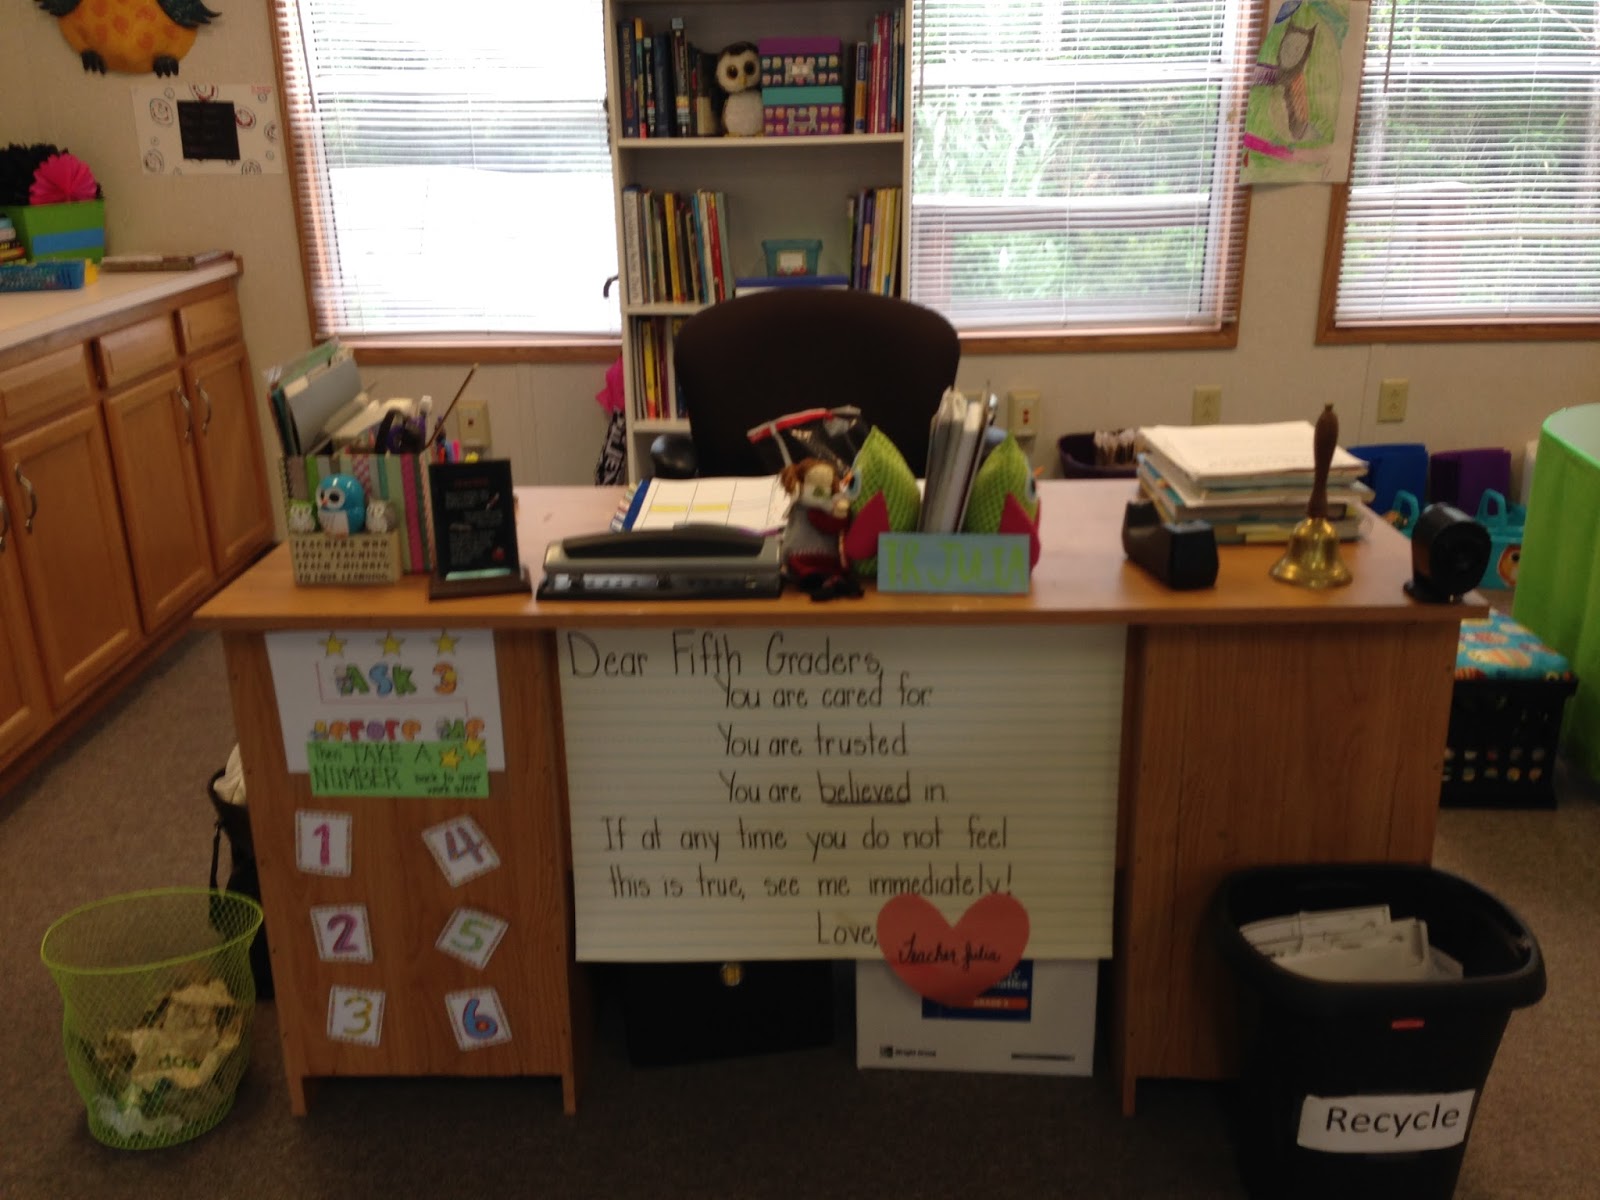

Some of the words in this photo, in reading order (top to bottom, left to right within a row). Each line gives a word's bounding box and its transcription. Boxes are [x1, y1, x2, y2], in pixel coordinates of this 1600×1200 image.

[567, 630, 648, 678] Dear
[672, 629, 743, 678] Fifth
[765, 631, 885, 678] Graders,
[432, 661, 458, 695] 3
[713, 672, 761, 708] You
[772, 688, 808, 708] are
[821, 672, 883, 708] cared
[345, 743, 403, 765] TAKE
[414, 742, 431, 762] A
[718, 722, 761, 757] You
[768, 734, 803, 757] are
[313, 764, 402, 791] NUMBER
[719, 770, 762, 804] You
[768, 781, 803, 804] are
[816, 769, 912, 805] believed
[313, 823, 330, 866] 1
[445, 826, 484, 864] 4
[603, 816, 626, 851] If
[642, 817, 661, 850] at
[680, 825, 720, 862] any
[738, 816, 787, 849] time
[807, 826, 847, 862] you
[863, 816, 890, 850] do
[903, 816, 942, 850] not
[968, 814, 1008, 850] feel
[609, 865, 650, 899] this
[662, 869, 684, 898] is
[699, 865, 746, 901] true,
[764, 875, 800, 897] see
[817, 873, 850, 897] me
[868, 864, 1013, 895] immediately!
[327, 912, 358, 953] 2
[450, 918, 494, 952] 5
[817, 910, 878, 948] Love,
[898, 933, 960, 966] Teacher
[961, 940, 1001, 972] Julia
[344, 996, 372, 1037] 3
[462, 998, 498, 1039] 6
[1326, 1104, 1460, 1138] Recycle
